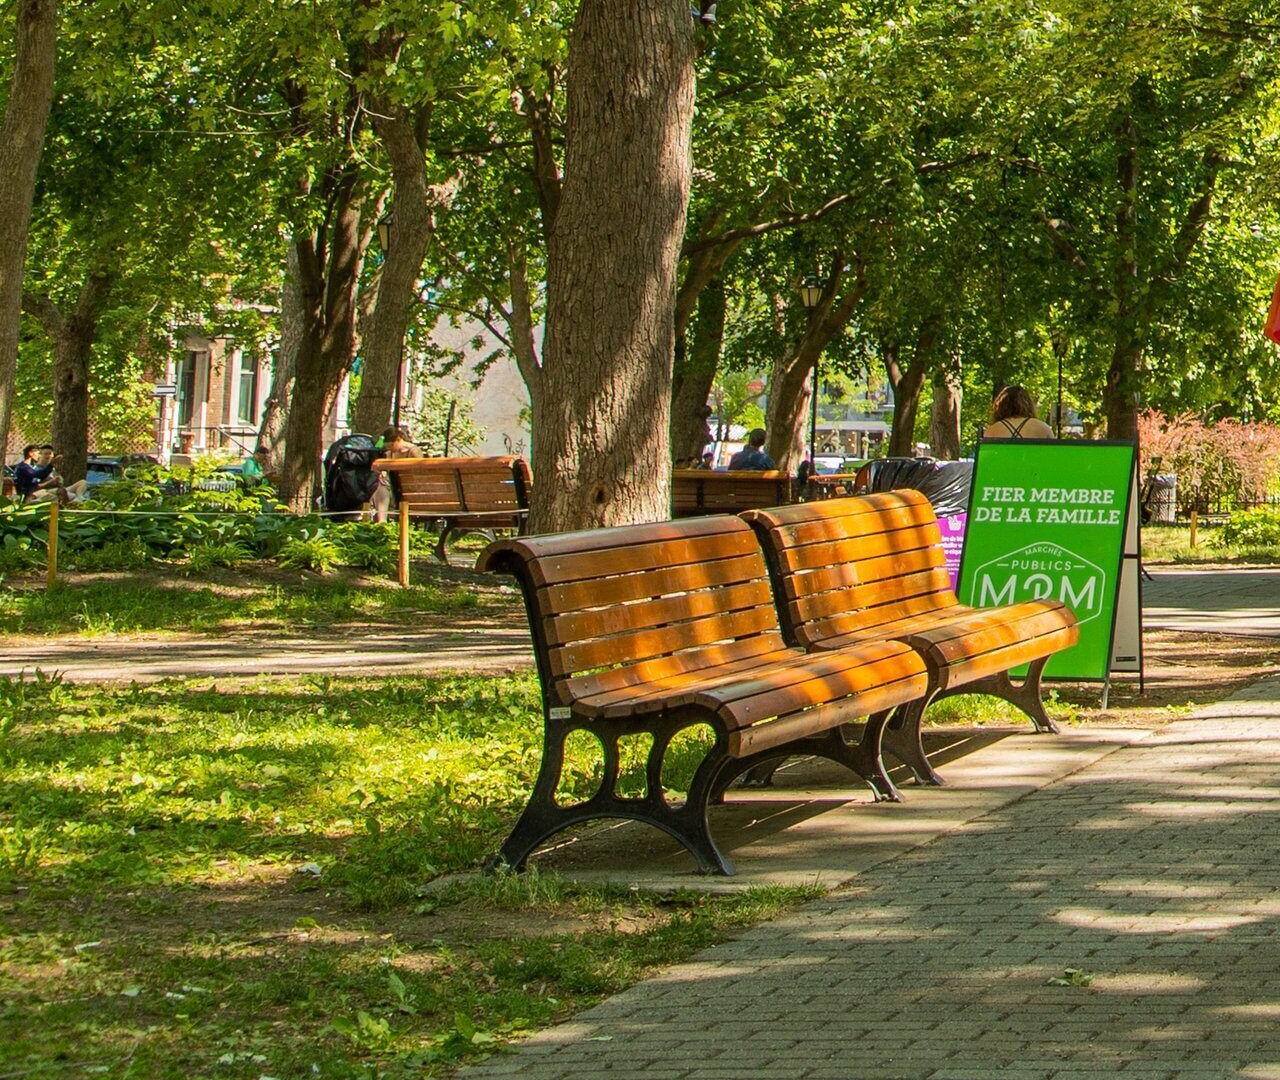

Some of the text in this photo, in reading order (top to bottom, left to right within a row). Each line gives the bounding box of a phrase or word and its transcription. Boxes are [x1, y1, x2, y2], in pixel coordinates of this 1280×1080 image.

[982, 486, 1115, 504] FIER MEMBRE
[975, 507, 1120, 524] DE LA FAMILLE
[1011, 560, 1072, 571] PUBLICS
